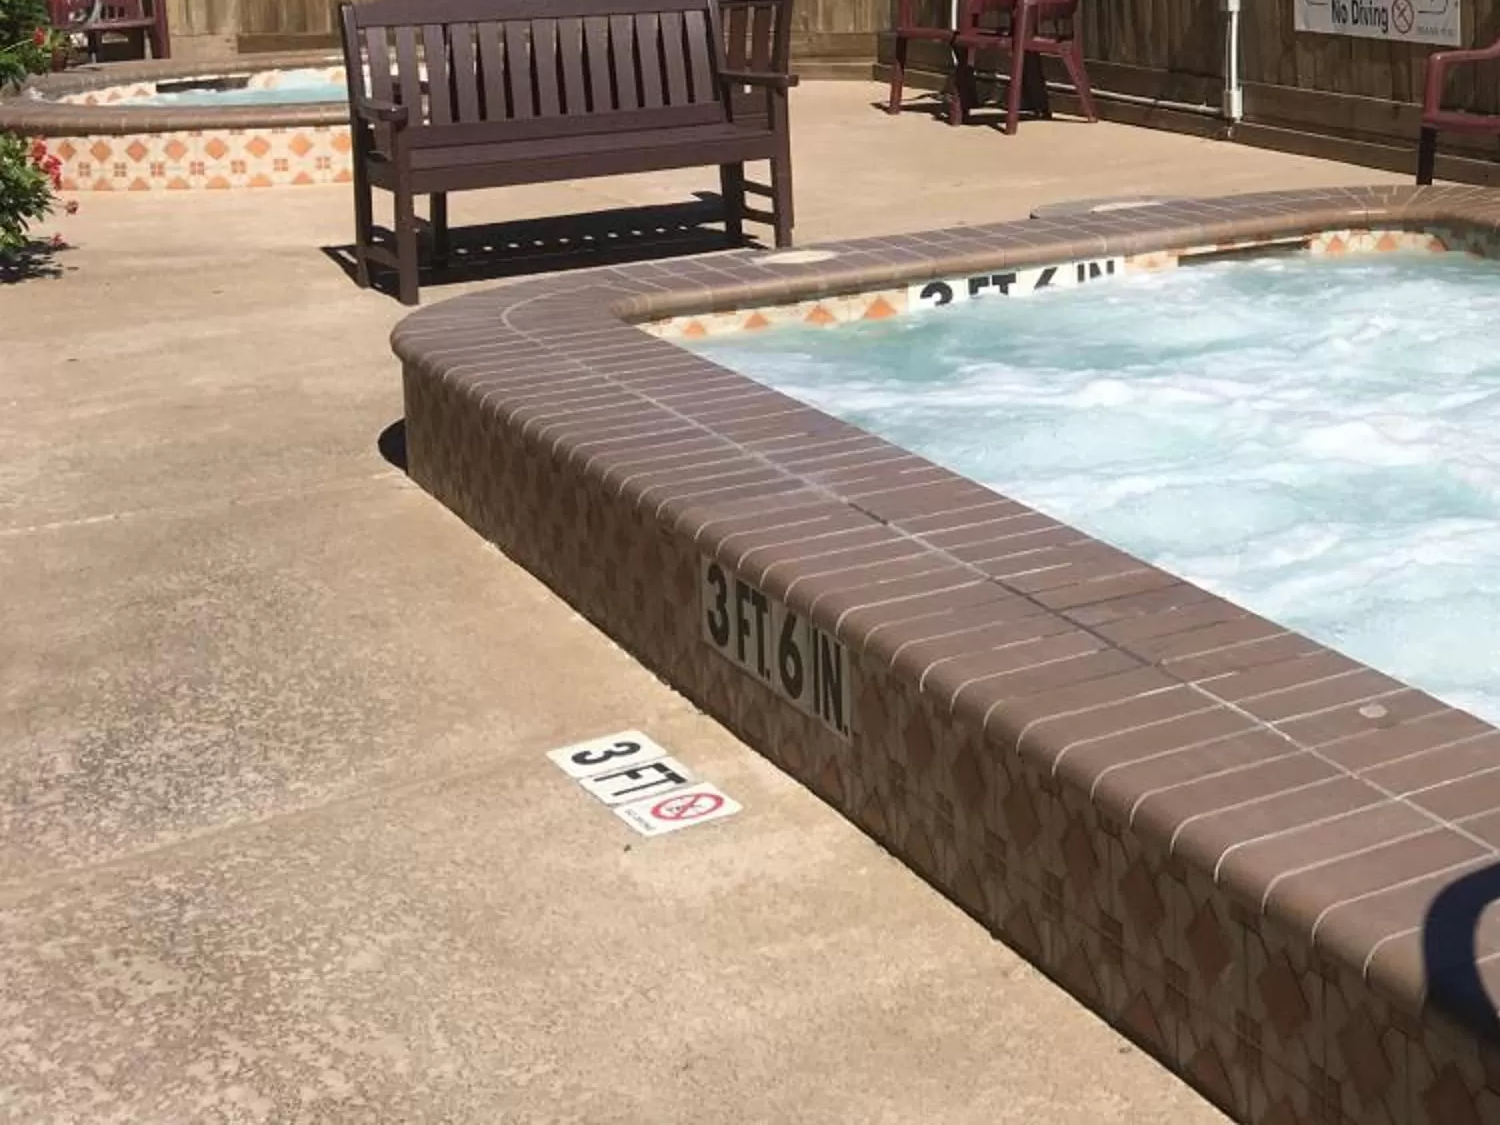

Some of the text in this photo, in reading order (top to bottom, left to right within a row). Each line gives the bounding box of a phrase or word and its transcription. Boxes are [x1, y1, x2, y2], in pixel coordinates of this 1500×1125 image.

[707, 563, 730, 648] 3
[779, 613, 804, 700] 6
[571, 741, 688, 797] 3 FT
